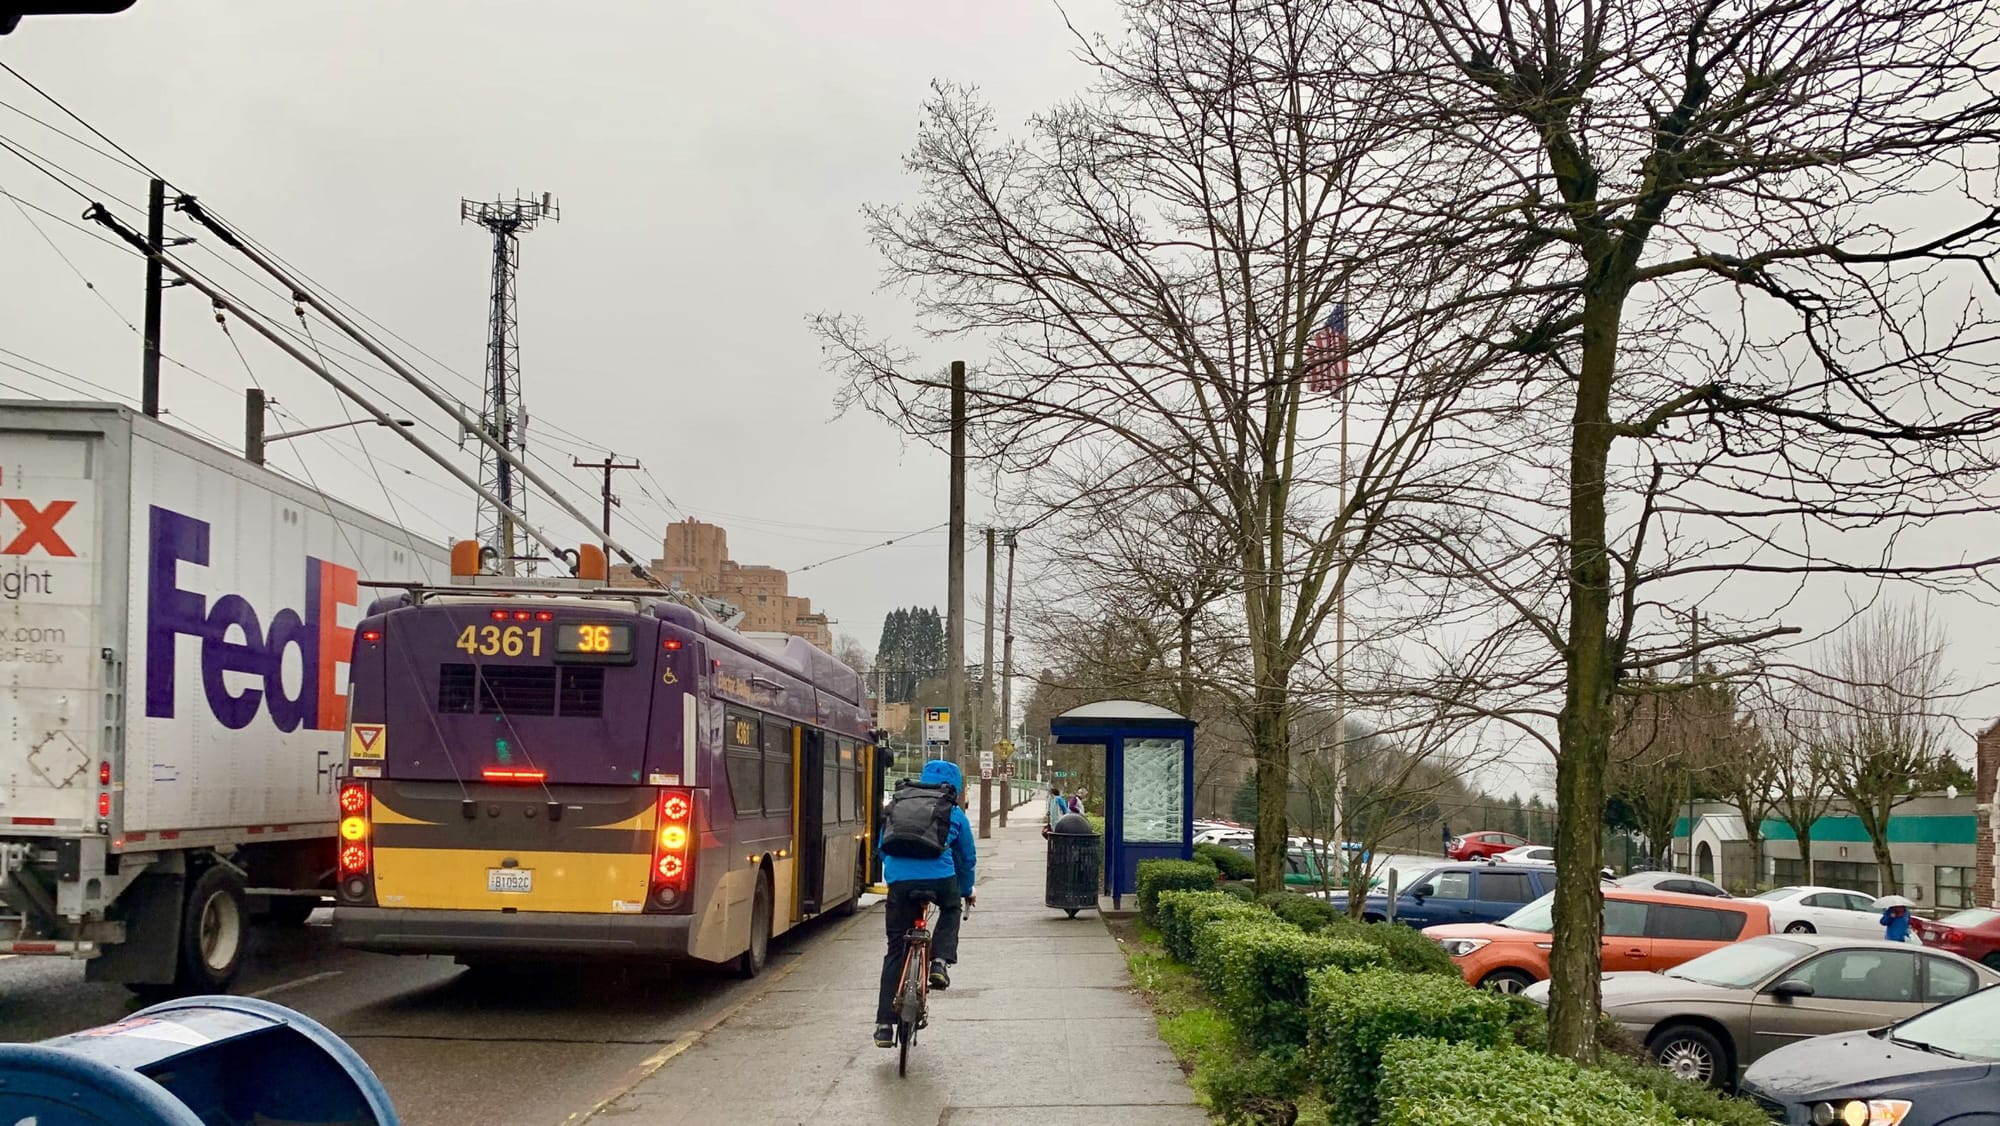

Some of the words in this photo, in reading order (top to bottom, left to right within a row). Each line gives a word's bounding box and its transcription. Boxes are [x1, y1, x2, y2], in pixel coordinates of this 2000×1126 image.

[0, 498, 77, 557] x
[456, 625, 542, 657] 4361
[578, 625, 611, 652] 36
[0, 648, 63, 664] oFedEx
[736, 720, 750, 745] 4361
